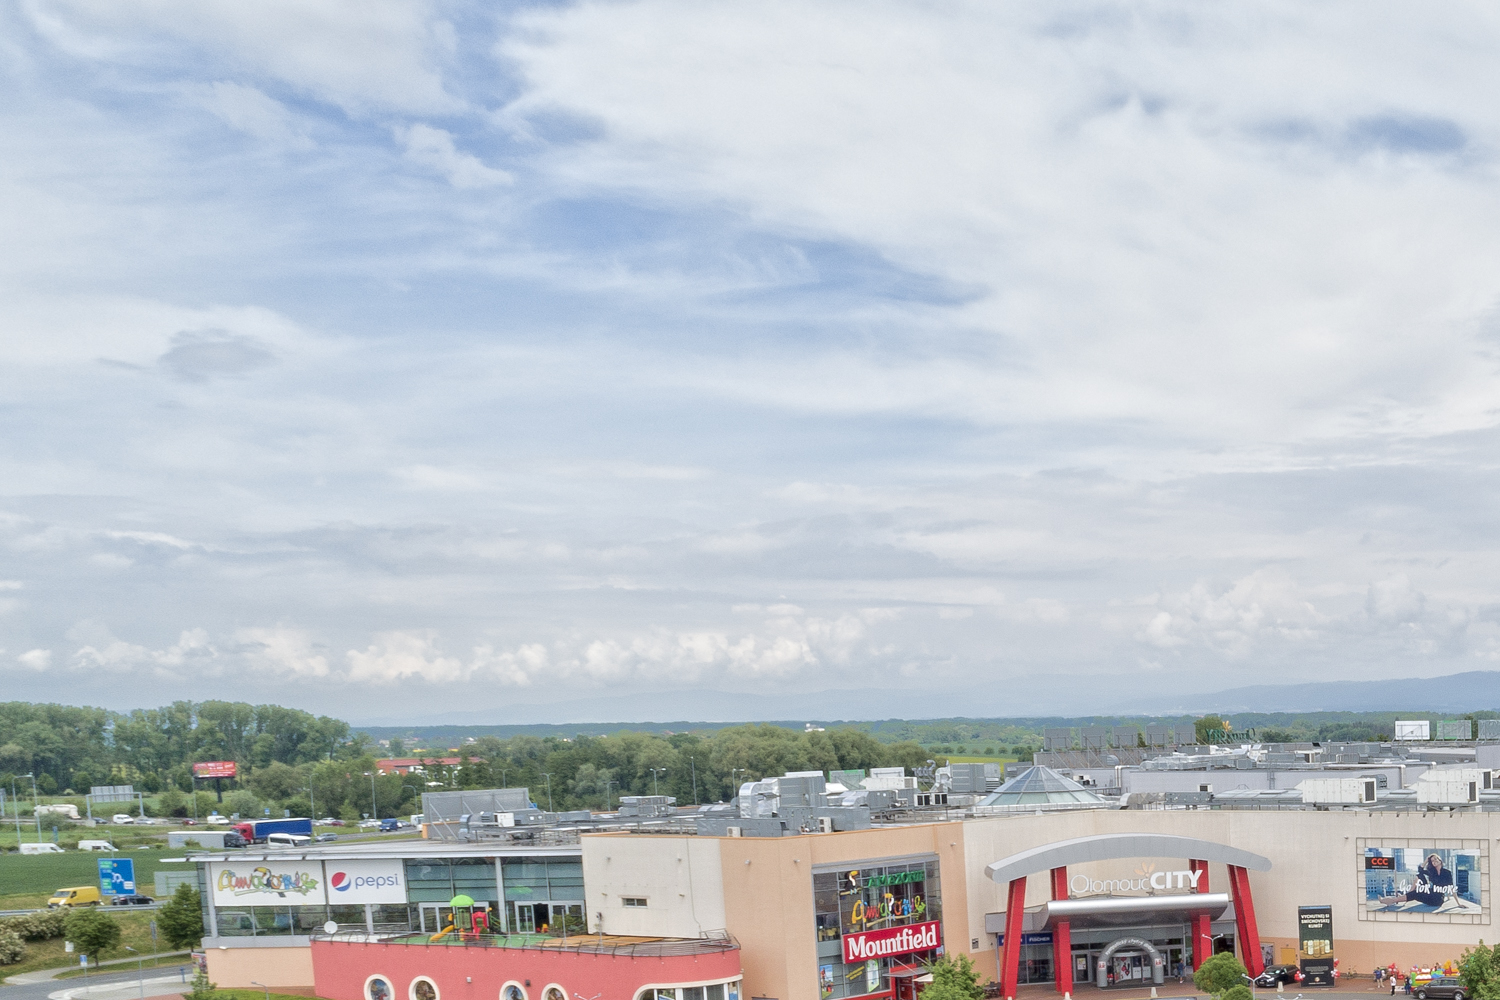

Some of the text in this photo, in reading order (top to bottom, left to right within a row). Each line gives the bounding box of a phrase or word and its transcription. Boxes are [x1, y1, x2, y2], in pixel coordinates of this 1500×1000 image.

[355, 874, 398, 892] pepsi
[1400, 879, 1412, 894] Go
[848, 924, 938, 960] Mountfield
